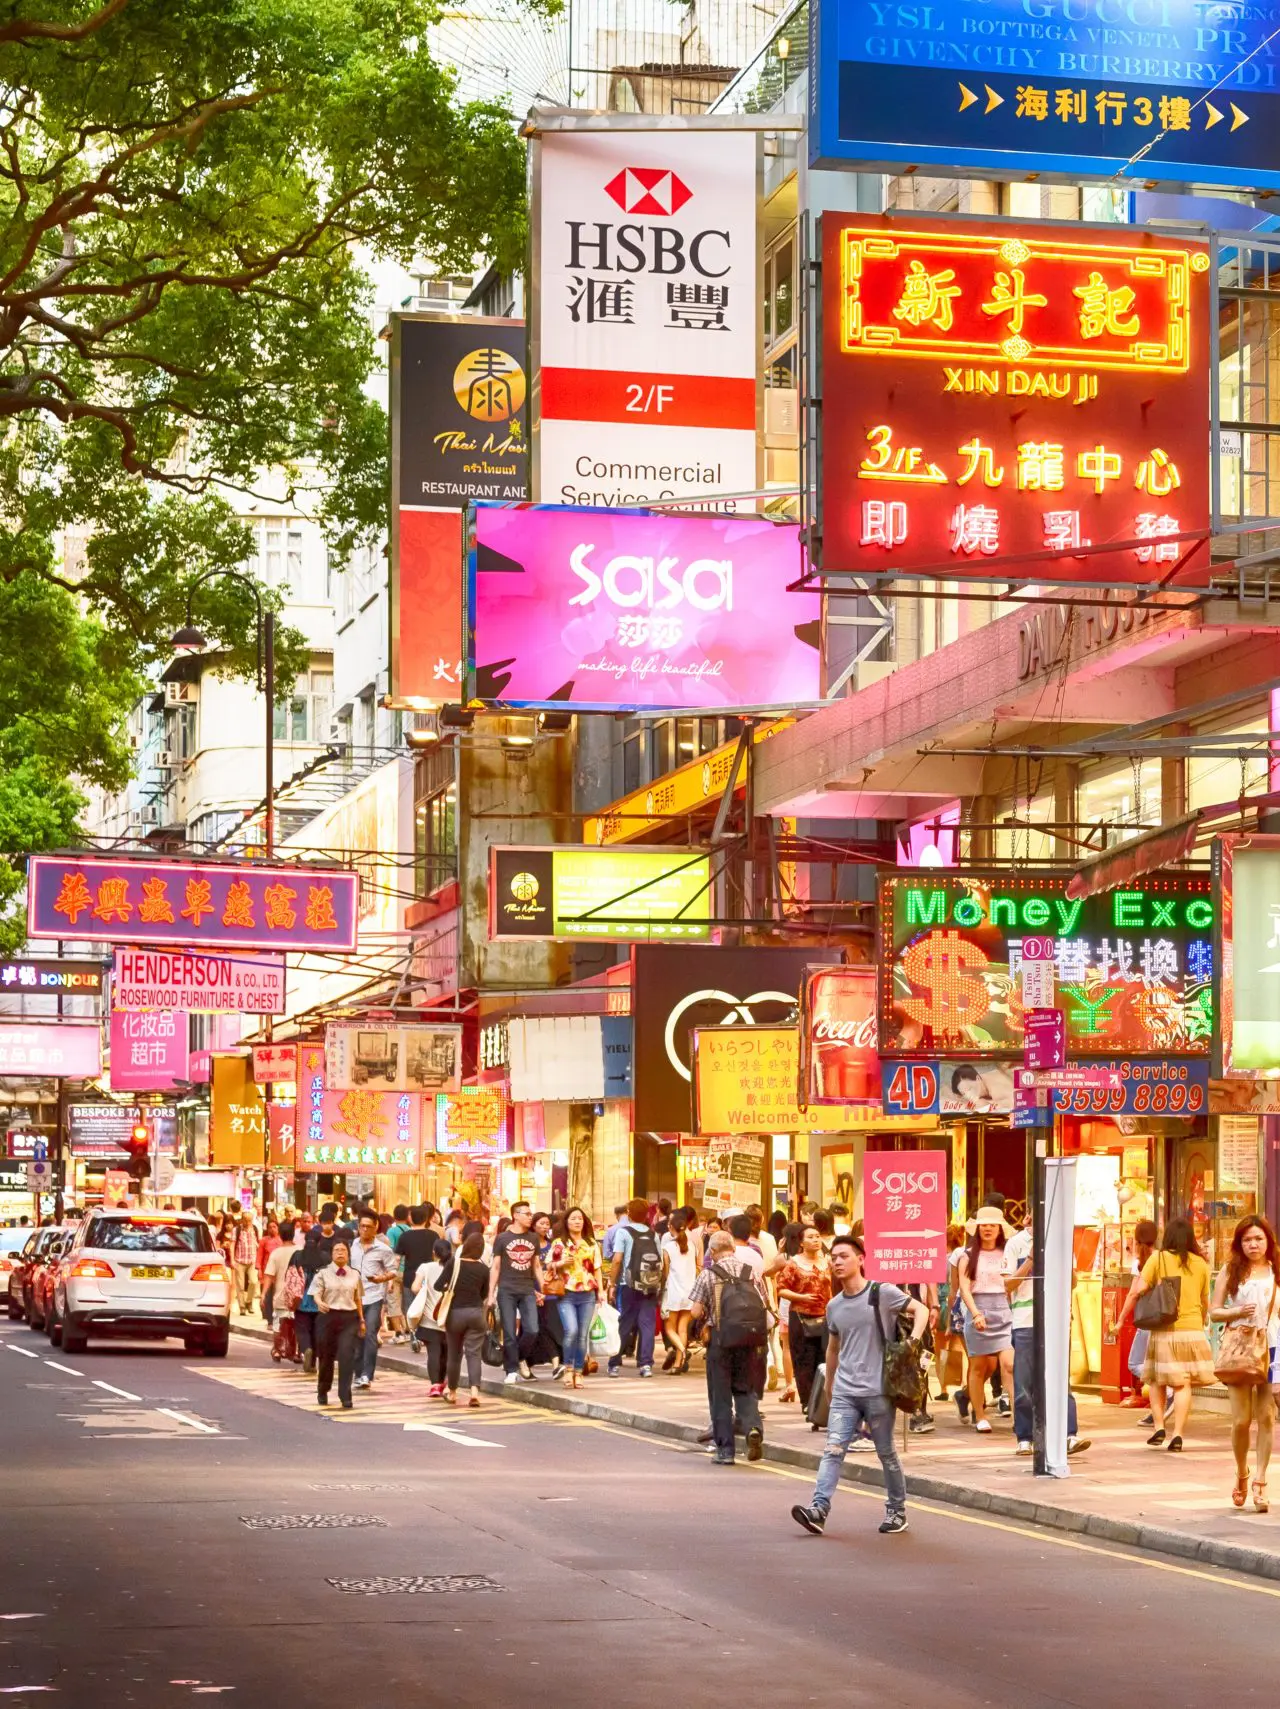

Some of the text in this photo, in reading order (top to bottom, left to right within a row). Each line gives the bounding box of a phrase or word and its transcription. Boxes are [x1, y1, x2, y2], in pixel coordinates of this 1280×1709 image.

[868, 2, 945, 32] YSL
[962, 18, 1077, 42] BOTTEGA
[1087, 27, 1181, 49] VENETA
[865, 36, 1042, 69] GIVENCHY
[1058, 51, 1224, 82] BURBERRY
[1014, 85, 1192, 131] 海利行3樓
[565, 220, 732, 277] HSBC
[893, 260, 1140, 340] 新斗記
[625, 384, 675, 413] 2/F
[943, 368, 1099, 405] XIN DAU JI
[433, 431, 478, 454] Thai
[575, 456, 722, 484] Commercial
[861, 425, 1182, 496] 3/F 九龍中心
[421, 482, 500, 496] RESTAURANT
[858, 500, 1181, 565] 即燒乳豬
[615, 614, 684, 650] 莎莎
[577, 655, 723, 680] making life beautiful
[54, 872, 339, 931] 華興蟲草燕窩莊
[906, 889, 1084, 935] Money
[40, 973, 99, 987] BONJOUR
[121, 955, 281, 989] HENDERSON & CO., LTD.
[120, 989, 279, 1010] ROSEWOOD FURNITURE & CHEST
[1034, 989, 1042, 1006] Sha
[131, 1041, 168, 1066] 超市
[1121, 1061, 1189, 1081] Service
[888, 1064, 938, 1110] 4D
[1054, 1083, 1128, 1113] 3599
[1132, 1083, 1205, 1113] 8899
[73, 1107, 176, 1117] BESPOKE TALORS
[228, 1103, 262, 1115] Watch
[728, 1110, 819, 1125] Welcome to
[943, 1099, 964, 1111] Body
[885, 1195, 922, 1221] 莎莎
